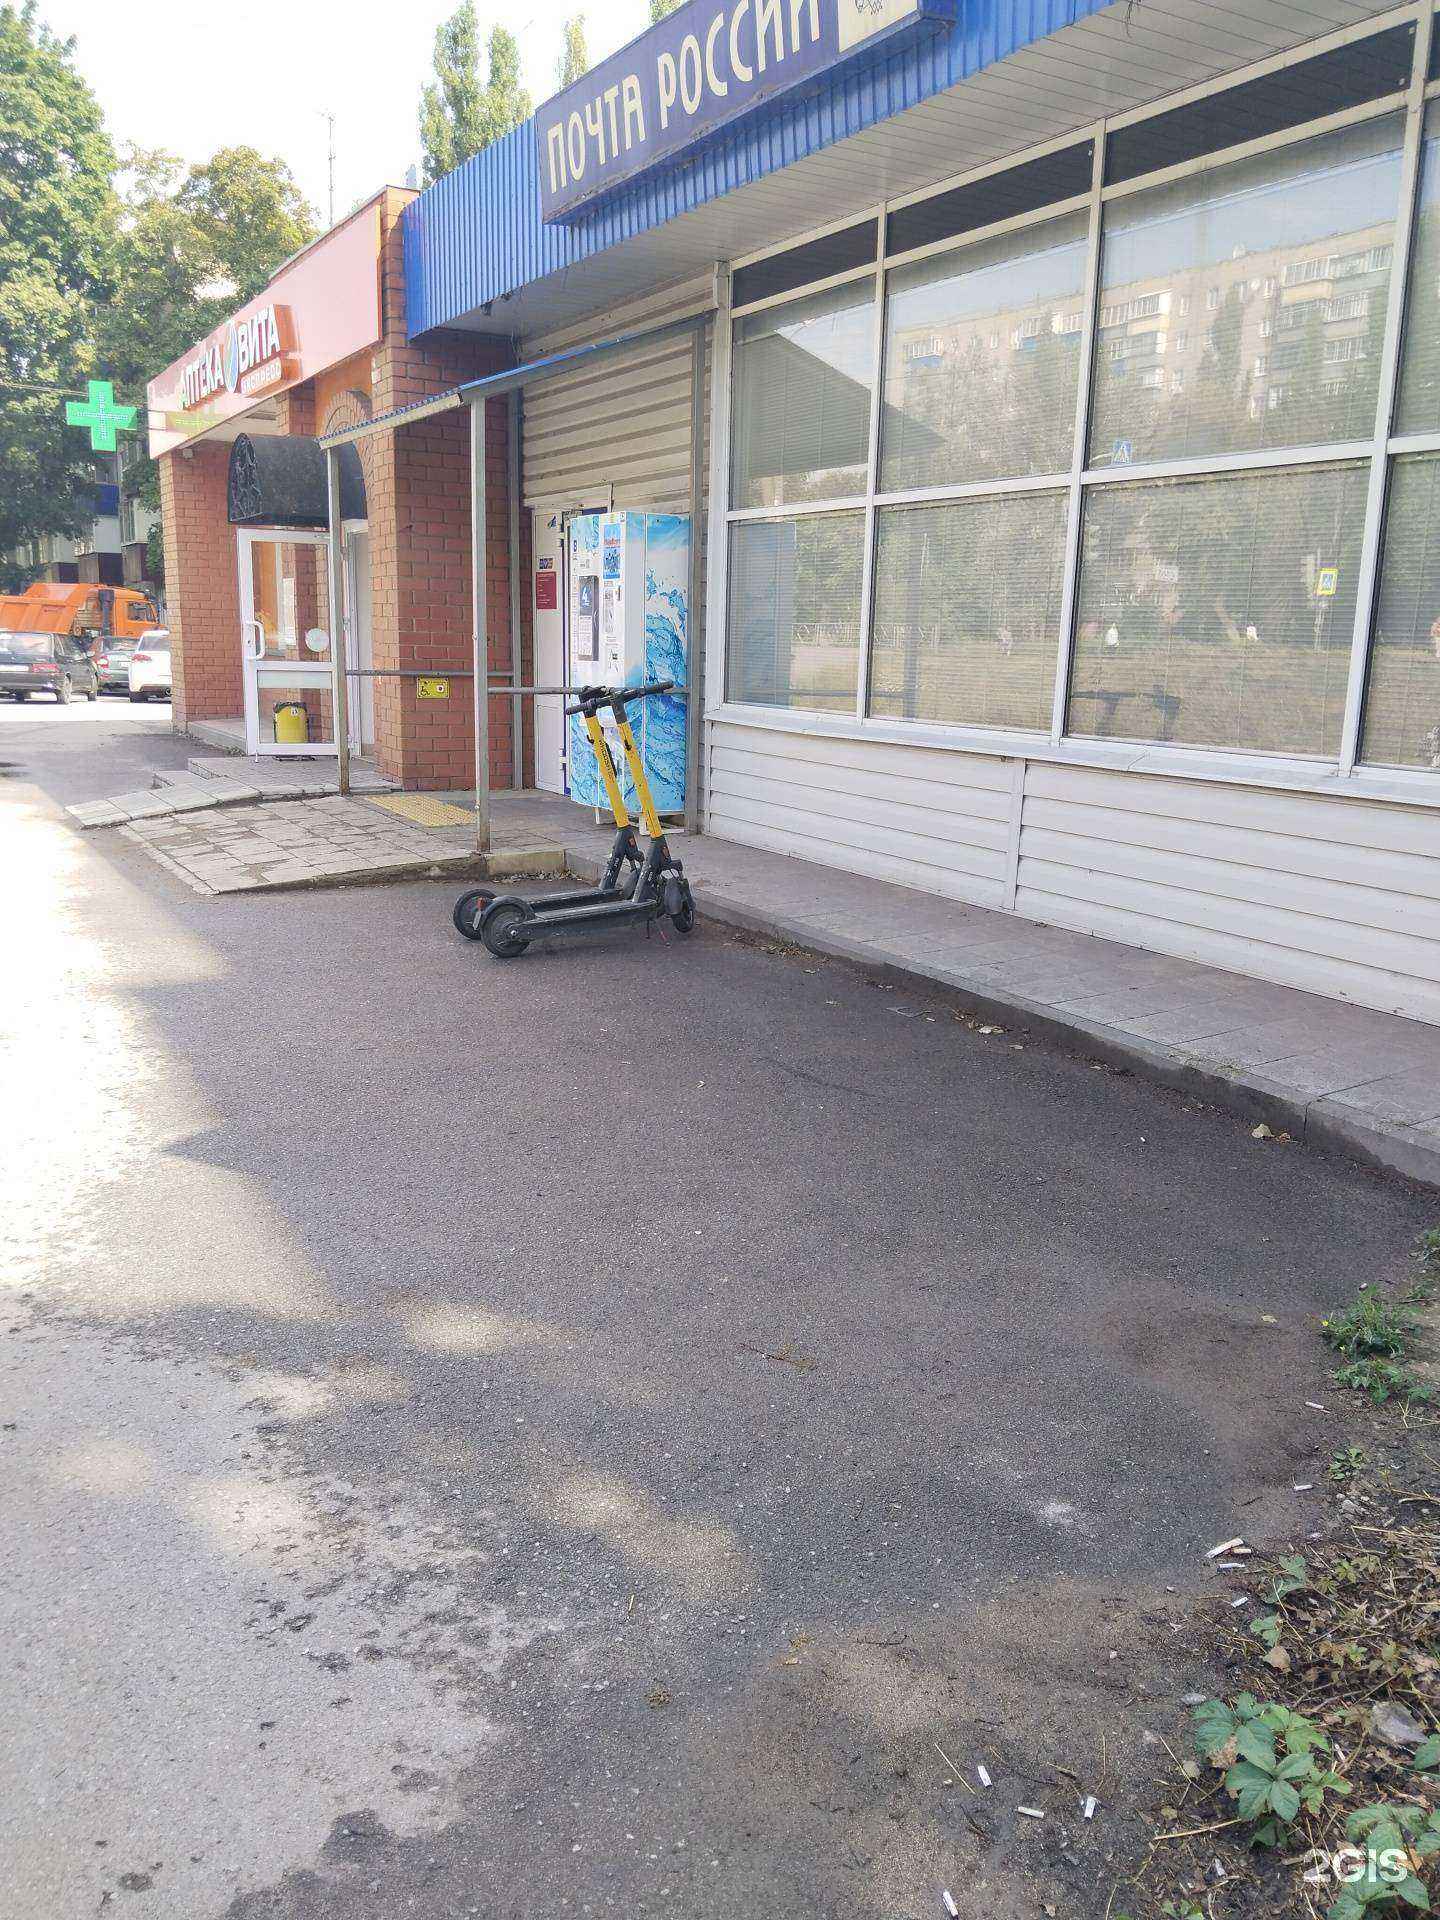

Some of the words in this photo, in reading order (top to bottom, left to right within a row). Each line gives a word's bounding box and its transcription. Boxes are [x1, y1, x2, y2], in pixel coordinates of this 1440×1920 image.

[547, 74, 647, 194] ПОЧТА
[178, 344, 225, 411] АПТЕКА
[238, 304, 281, 373] ВИТА
